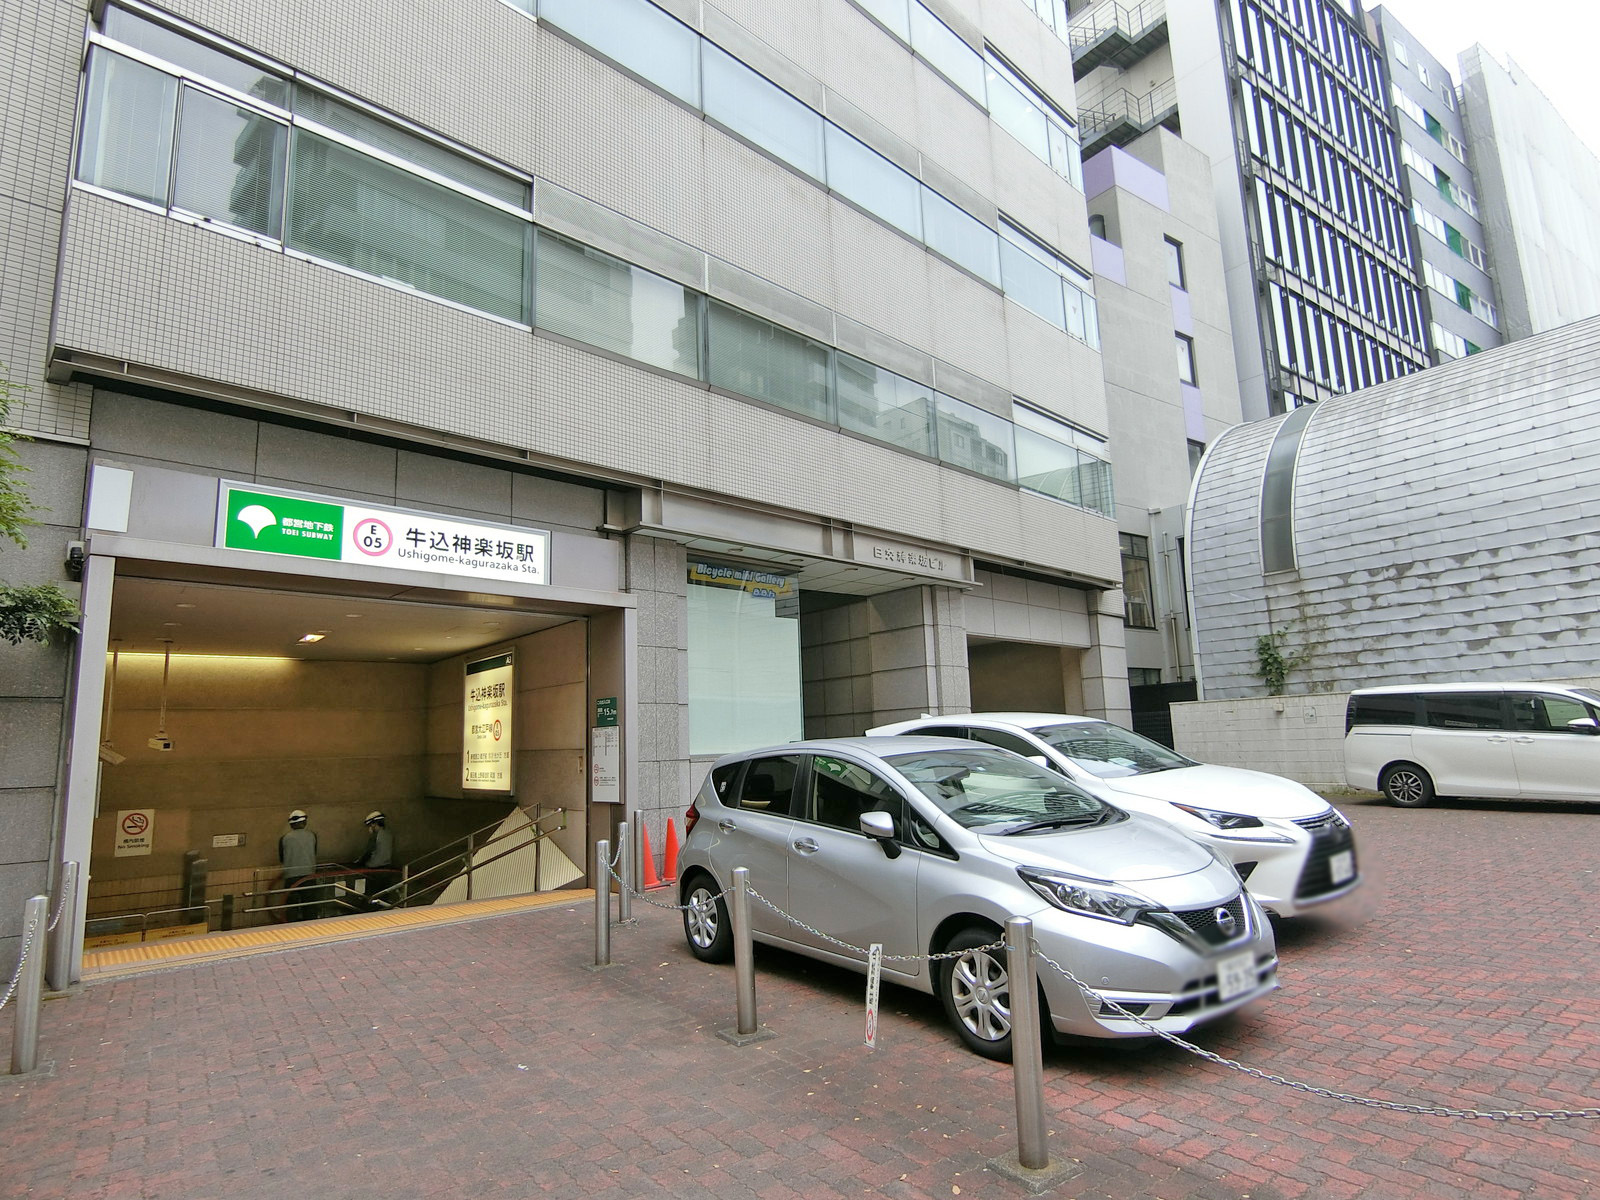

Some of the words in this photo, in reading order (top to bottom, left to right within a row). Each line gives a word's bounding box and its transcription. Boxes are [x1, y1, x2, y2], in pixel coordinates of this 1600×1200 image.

[282, 517, 334, 532] 都営地下鉄
[370, 524, 377, 535] E
[282, 528, 299, 537] TOEI
[301, 530, 334, 541] SUBWAY
[363, 536, 382, 548] 05
[406, 527, 534, 563] 牛込神楽坂駅
[398, 548, 519, 572] Ushigome-kagurazaka
[521, 563, 540, 575] Sta.
[696, 562, 732, 580] Bicycle
[755, 572, 785, 589] Gallery
[465, 767, 470, 782] 2
